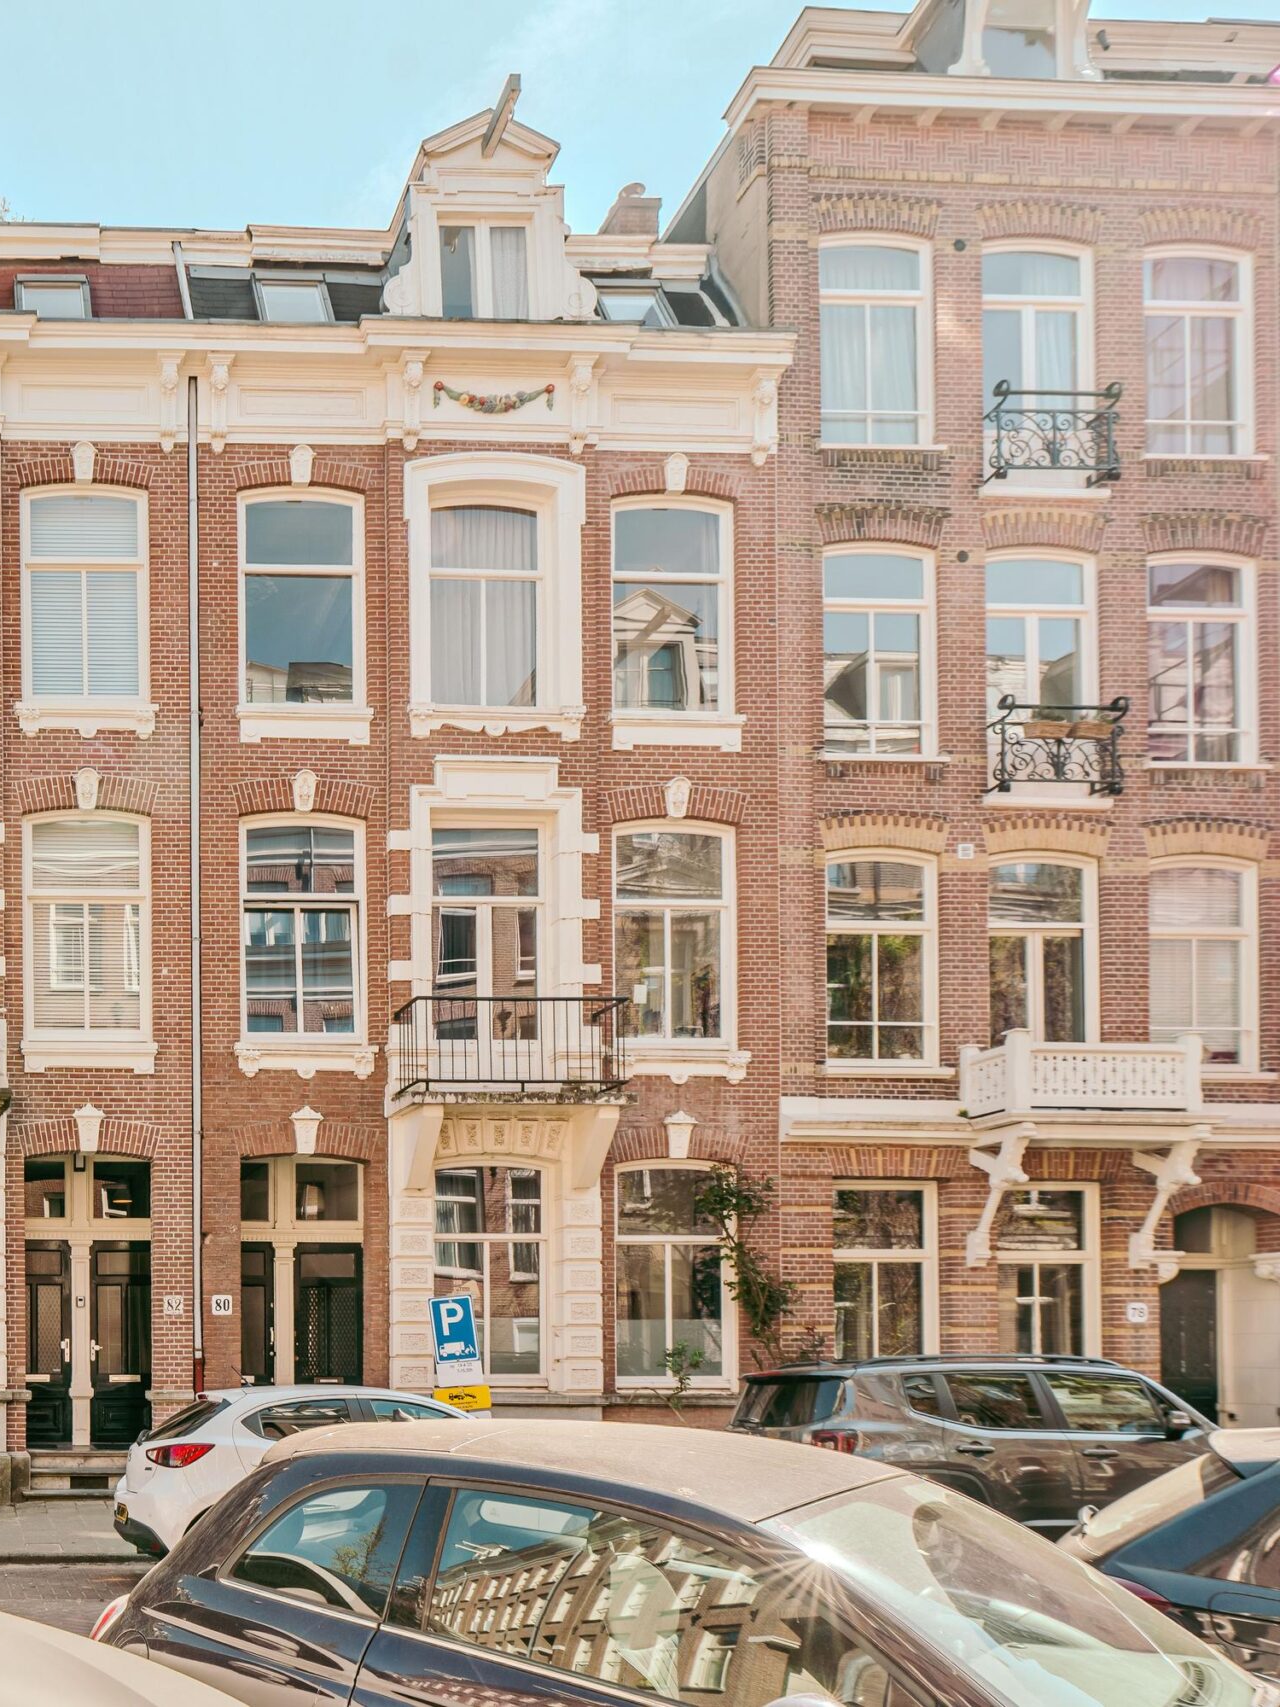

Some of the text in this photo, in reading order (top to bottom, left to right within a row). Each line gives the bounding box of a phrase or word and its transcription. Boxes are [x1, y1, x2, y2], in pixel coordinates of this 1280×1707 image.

[166, 1298, 182, 1311] 82
[215, 1298, 230, 1312] 80
[439, 1302, 464, 1336] P
